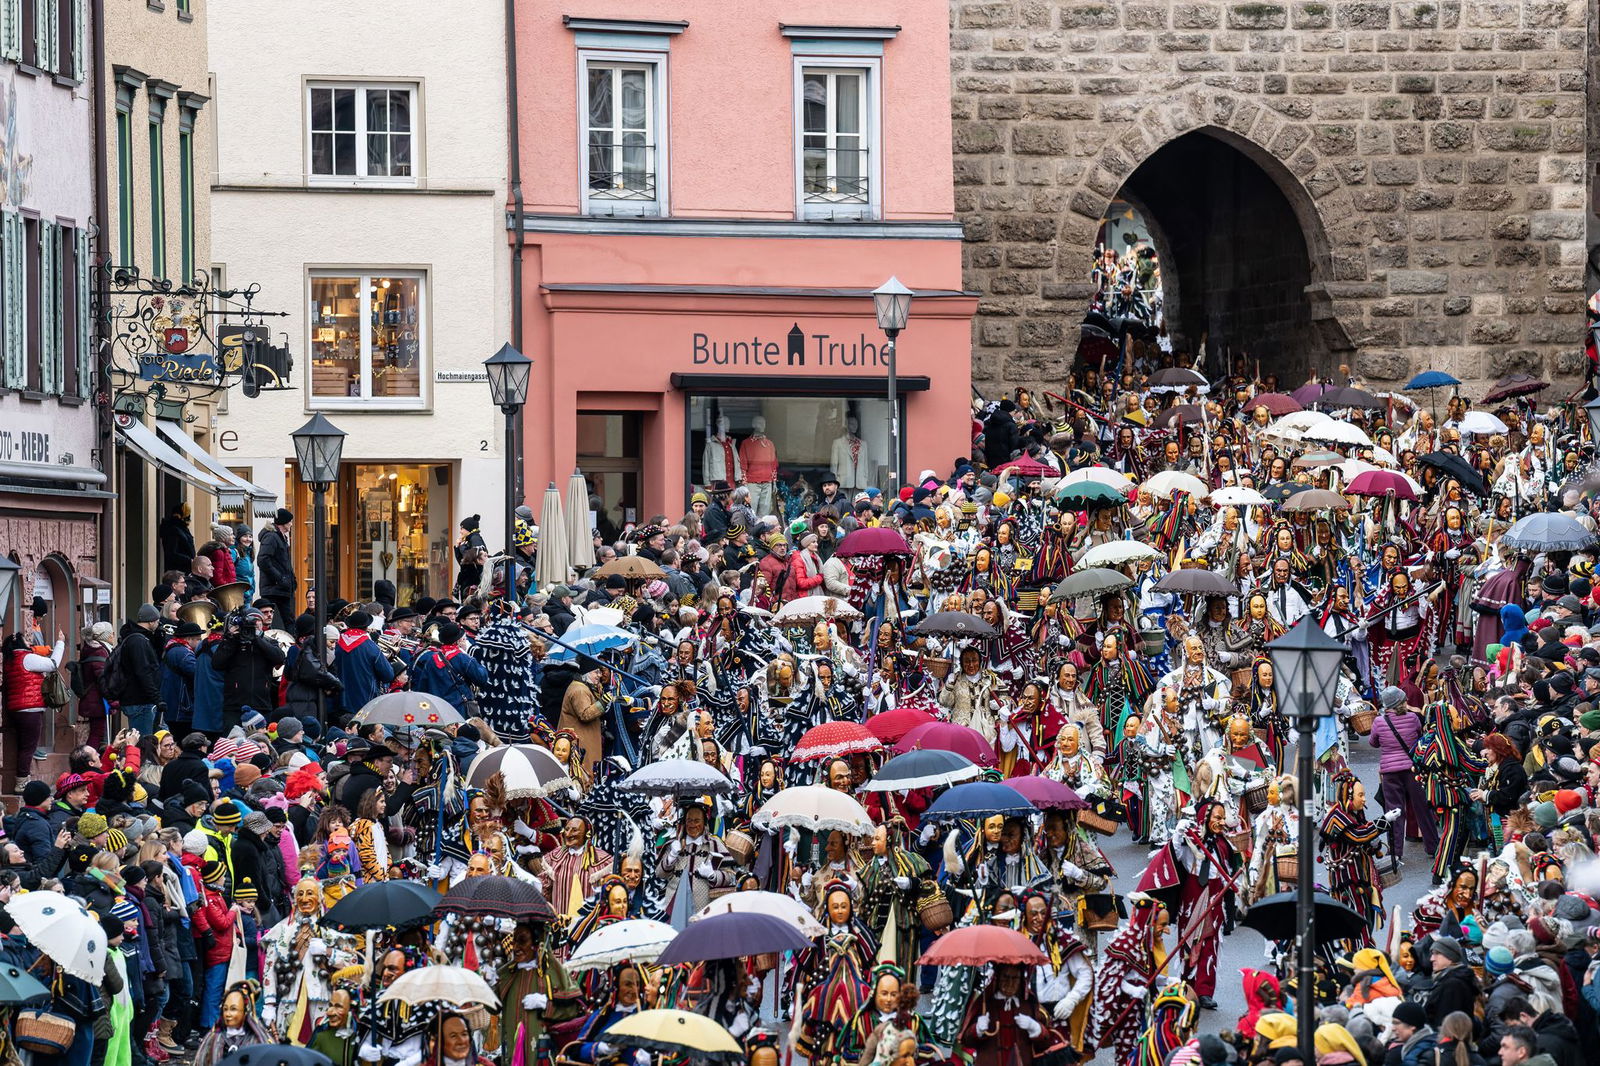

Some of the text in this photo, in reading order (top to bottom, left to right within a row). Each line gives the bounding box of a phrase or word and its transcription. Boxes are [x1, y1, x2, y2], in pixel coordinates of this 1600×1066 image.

[693, 333, 889, 366] Bunte Truhe
[140, 355, 164, 365] FOTO
[153, 359, 213, 379] Riede
[437, 371, 489, 381] Hochmaiengasse
[21, 431, 49, 463] RIEDE
[480, 440, 488, 451] 2
